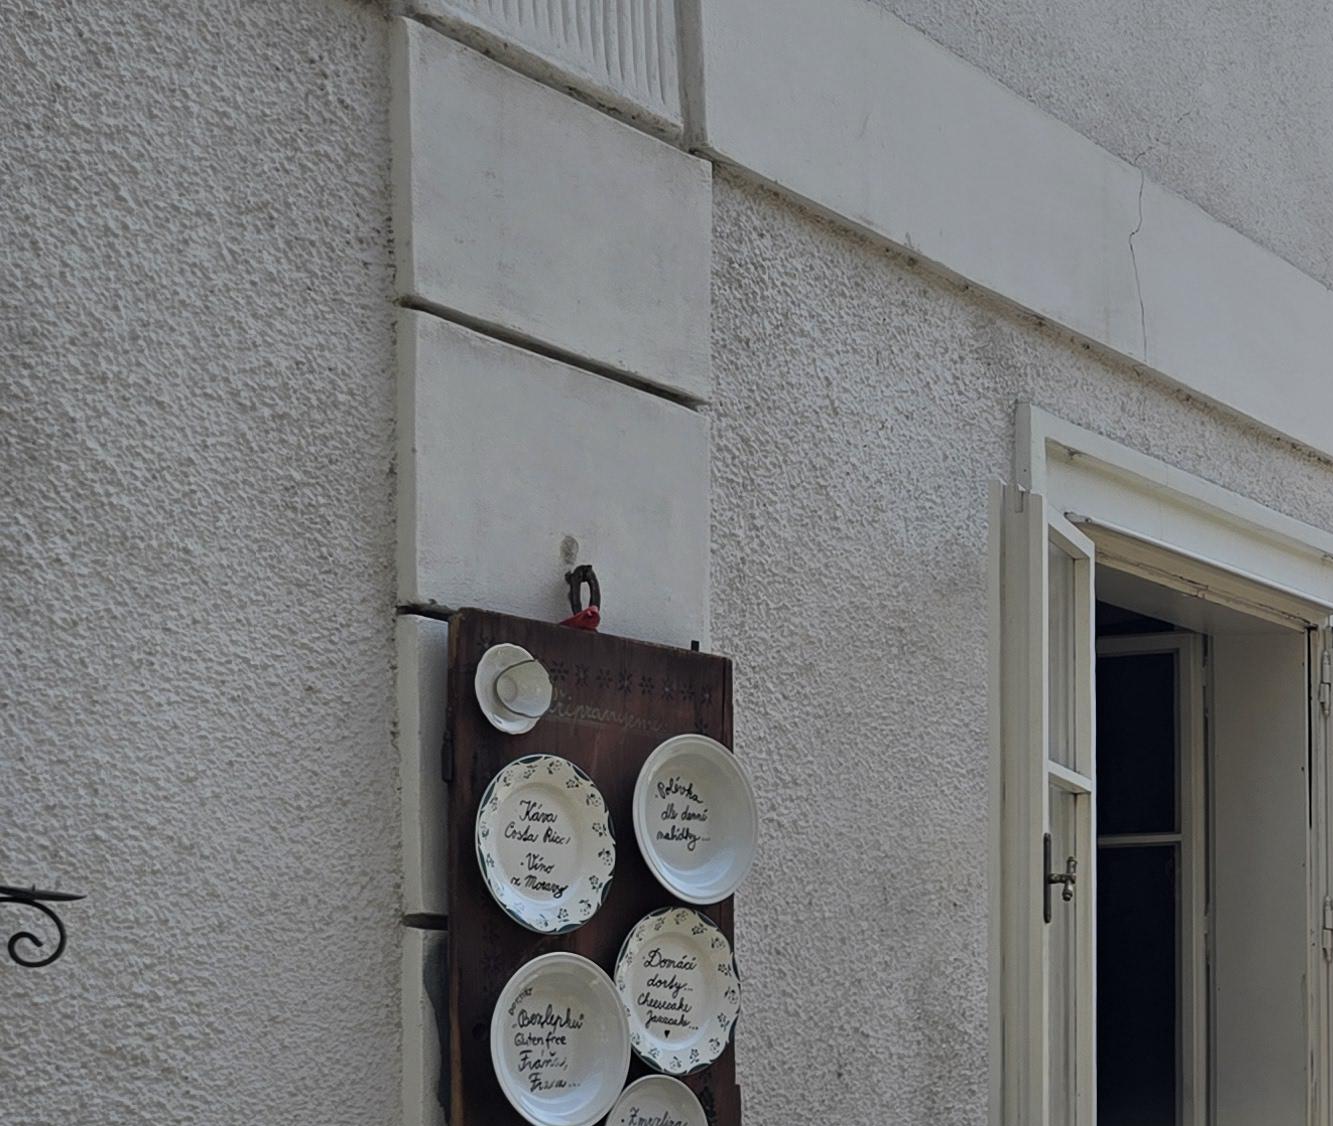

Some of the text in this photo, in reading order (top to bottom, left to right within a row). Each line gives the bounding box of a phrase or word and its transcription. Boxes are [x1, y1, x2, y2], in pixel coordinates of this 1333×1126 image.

[657, 777, 703, 803] Polévka
[520, 800, 558, 823] Káva
[505, 821, 539, 843] Costa
[526, 852, 555, 874] Víno
[525, 875, 568, 899] Moravy
[643, 947, 697, 970] Domácí
